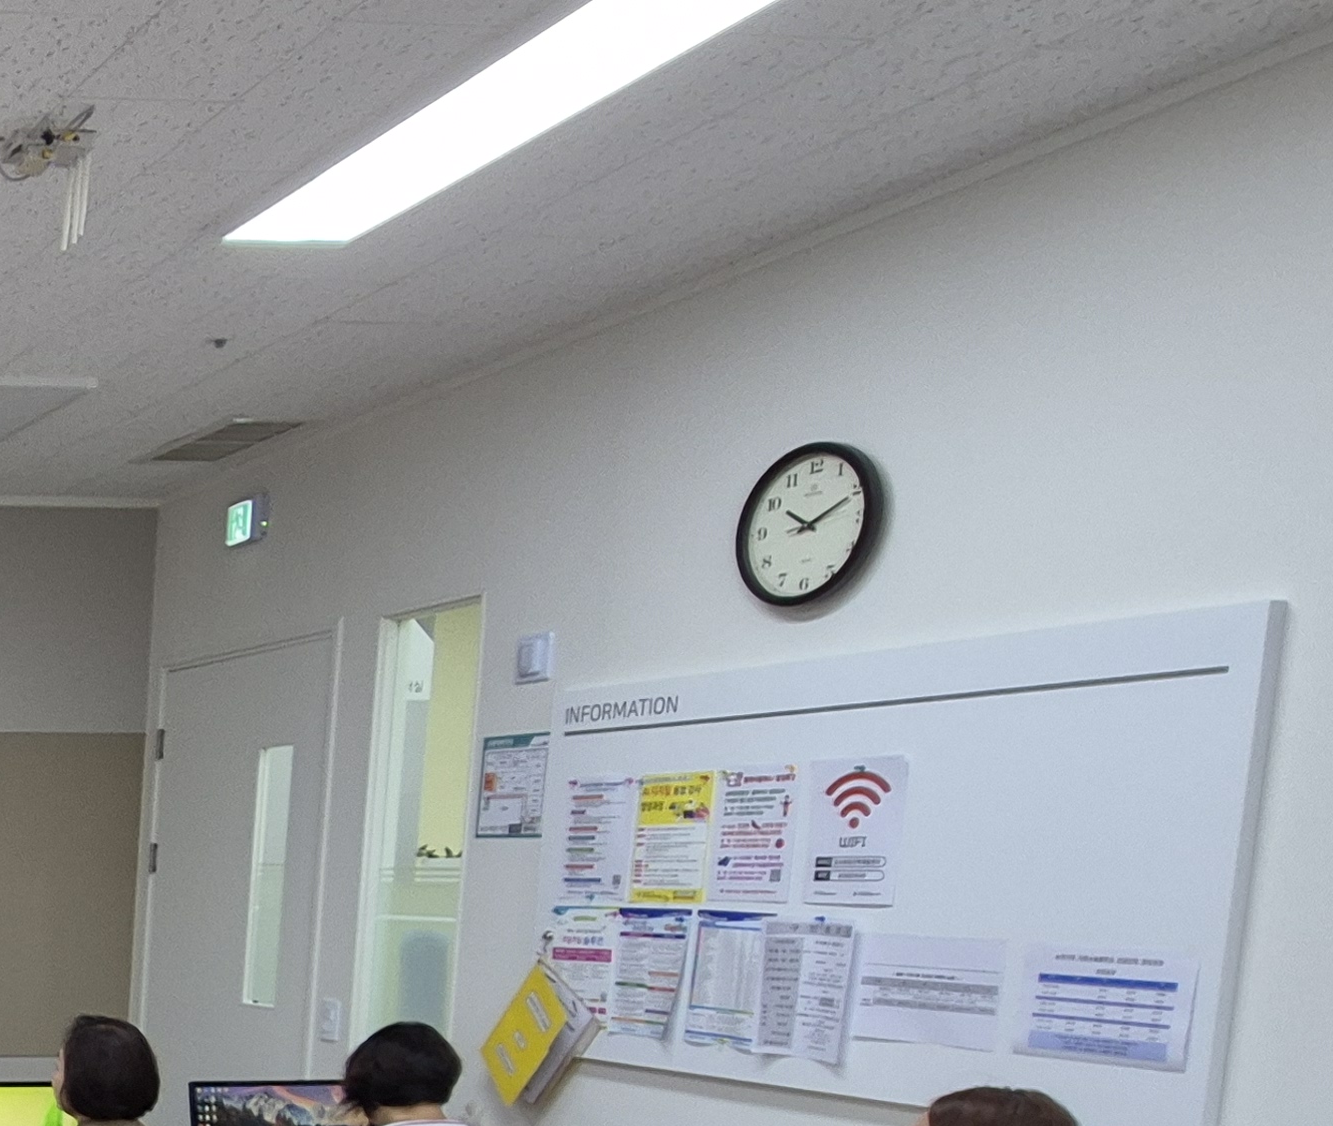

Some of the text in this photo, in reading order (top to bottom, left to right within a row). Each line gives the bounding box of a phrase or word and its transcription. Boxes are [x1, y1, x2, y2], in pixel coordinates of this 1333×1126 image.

[809, 459, 824, 475] 12
[837, 462, 844, 476] 1
[786, 473, 799, 488] 11
[767, 496, 782, 512] 10
[757, 526, 768, 542] 9
[761, 555, 773, 569] 8
[777, 572, 787, 588] 7
[799, 578, 810, 591] 6
[564, 695, 679, 725] INFORMATION
